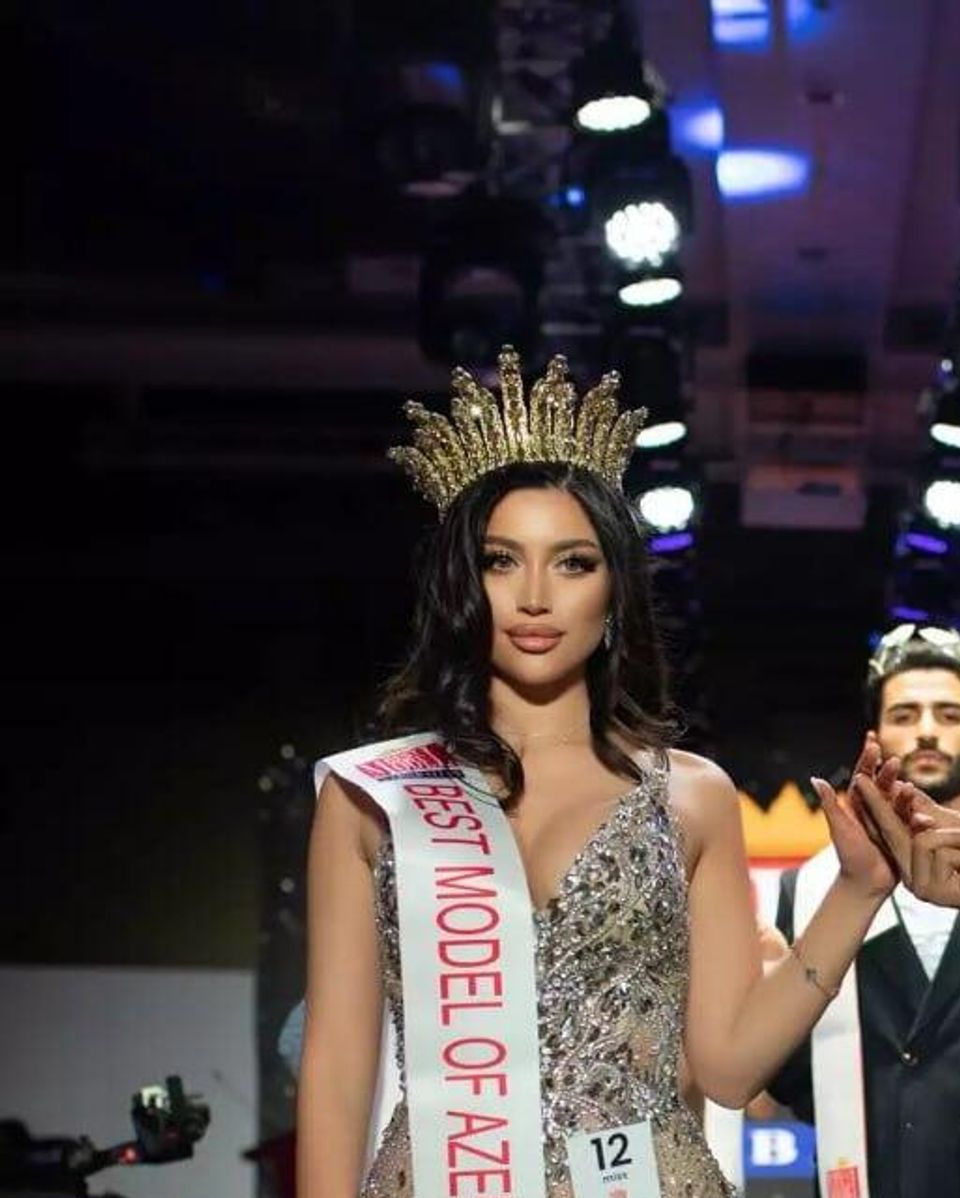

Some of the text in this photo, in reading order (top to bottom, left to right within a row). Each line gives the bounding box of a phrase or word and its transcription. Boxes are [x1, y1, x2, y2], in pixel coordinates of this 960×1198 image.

[404, 783, 491, 855] BEST
[434, 865, 504, 1027] MODEL
[442, 1037, 508, 1097] OF
[590, 1132, 632, 1171] 12
